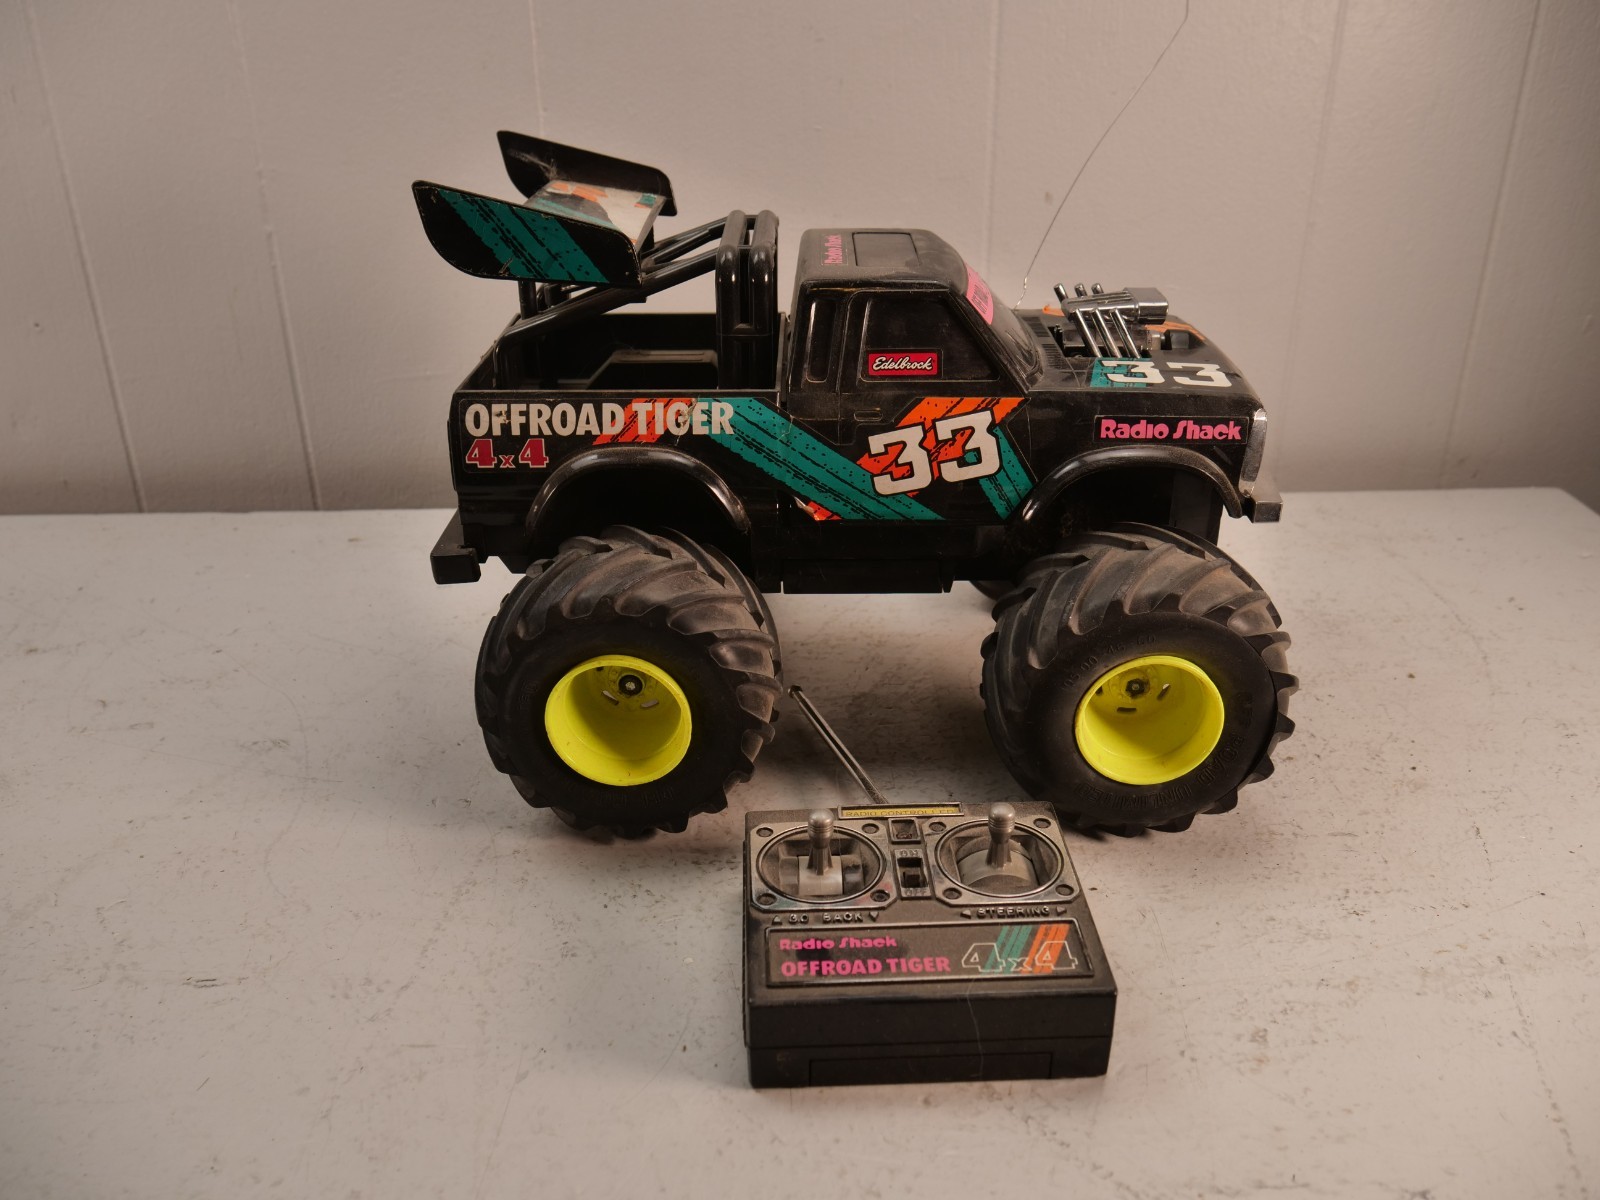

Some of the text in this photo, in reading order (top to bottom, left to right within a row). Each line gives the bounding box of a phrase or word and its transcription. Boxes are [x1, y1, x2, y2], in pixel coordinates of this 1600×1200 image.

[873, 356, 933, 371] Edelbrock
[1101, 360, 1233, 388] 33
[465, 402, 734, 437] OFFROAD TIGER
[1100, 418, 1242, 440] Radio Shack
[465, 438, 550, 469] 4x4
[868, 410, 1001, 496] 33
[977, 905, 1051, 919] STEERING
[779, 935, 898, 950] Radio Shack
[781, 957, 951, 977] OFFROAD TIGER
[961, 940, 1079, 973] 4x4
